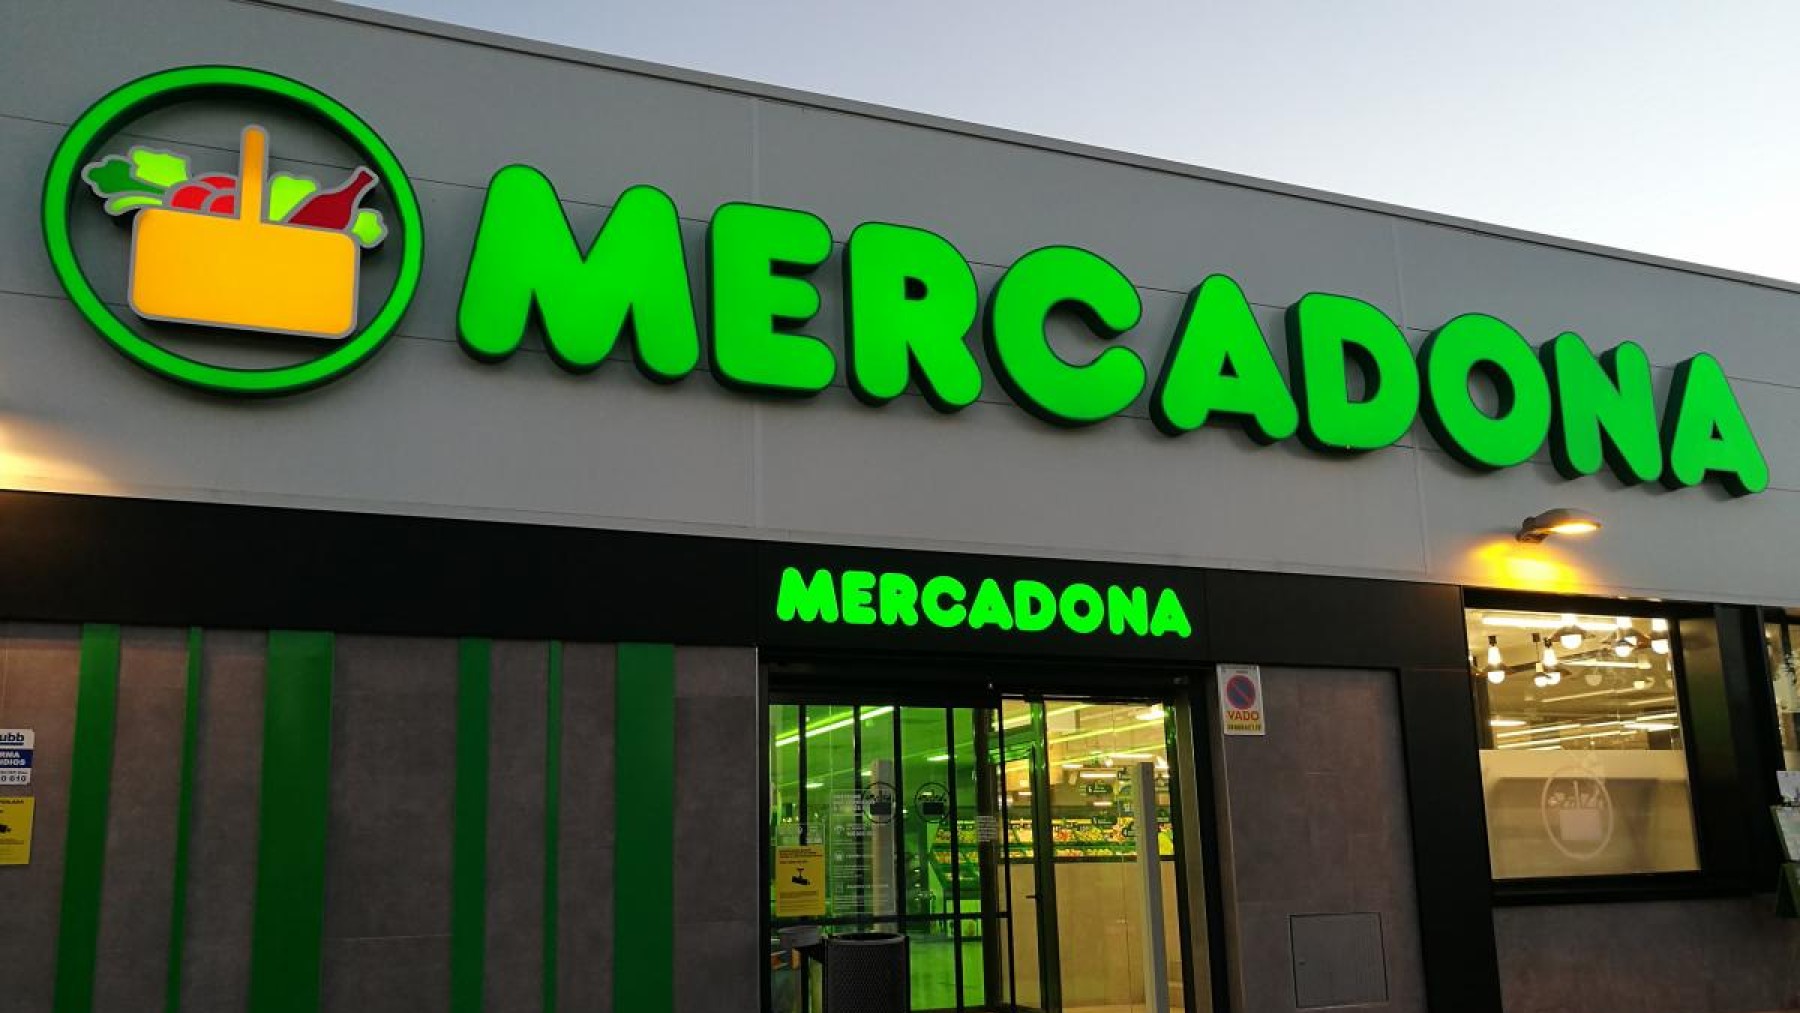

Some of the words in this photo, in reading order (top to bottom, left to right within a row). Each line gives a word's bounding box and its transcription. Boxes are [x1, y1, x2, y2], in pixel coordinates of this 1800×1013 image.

[458, 164, 1769, 494] MERCADONA
[776, 567, 1192, 638] MERCADONA
[1226, 710, 1260, 721] VADO
